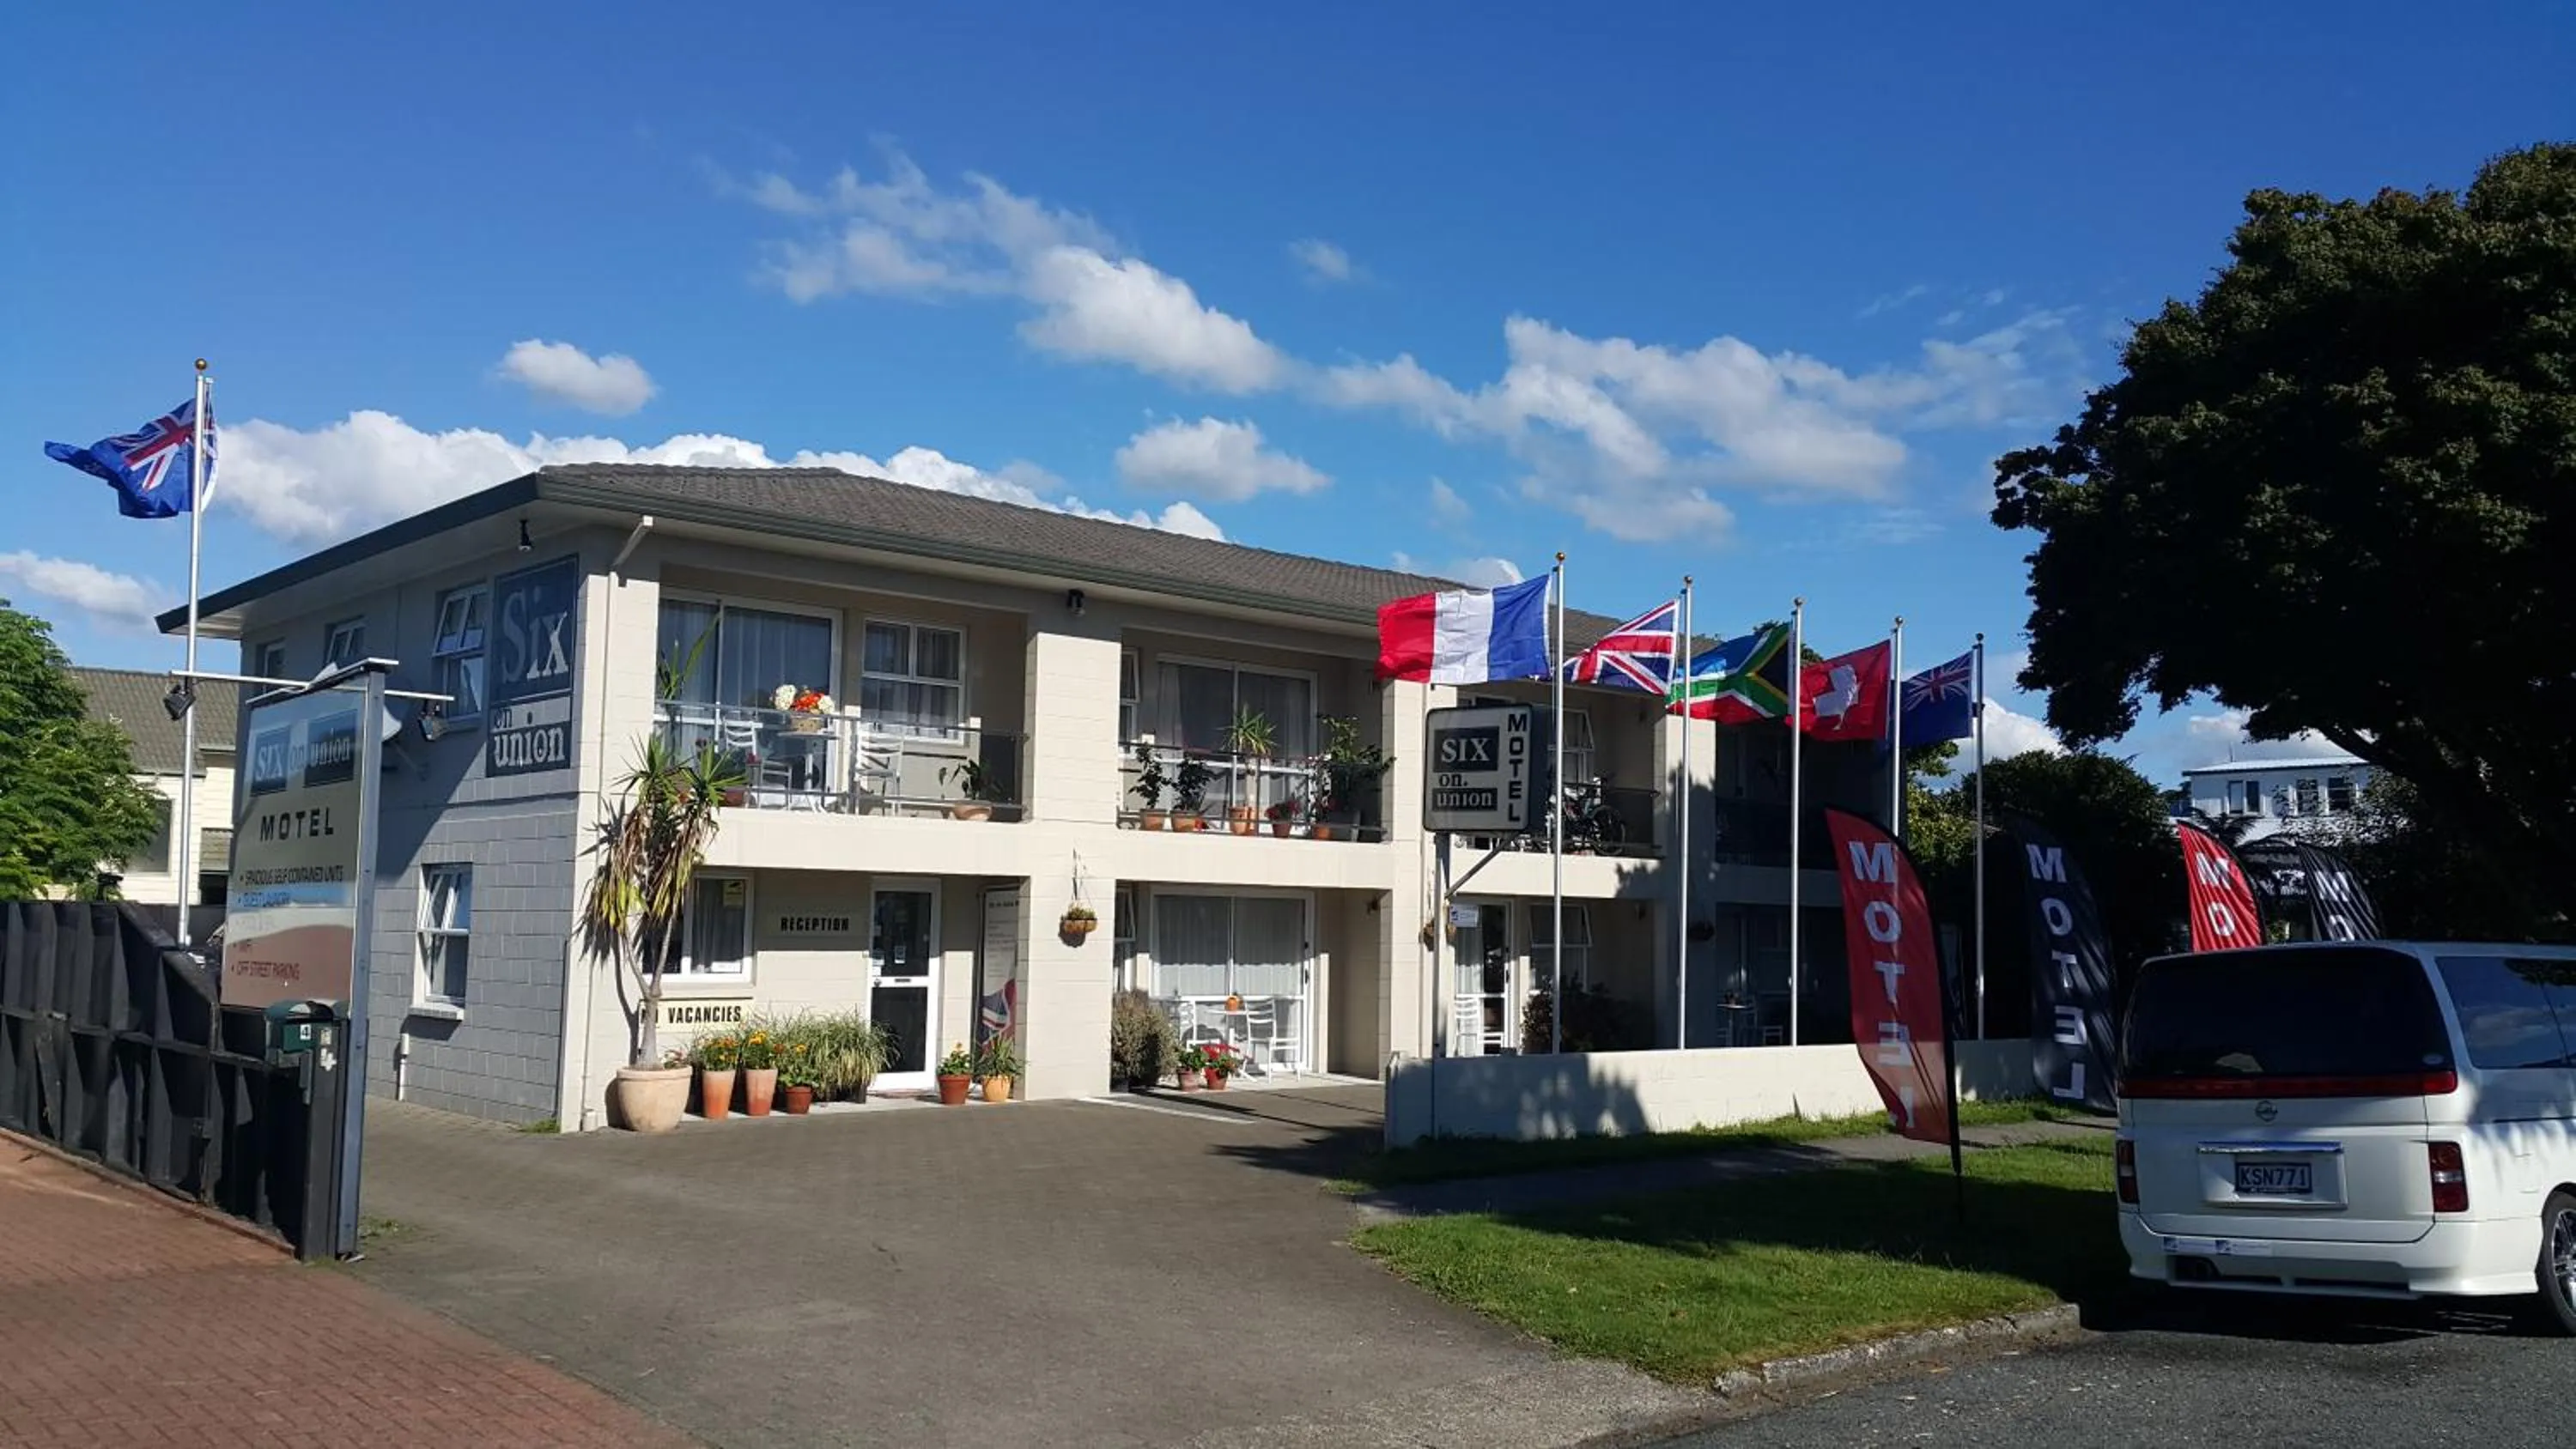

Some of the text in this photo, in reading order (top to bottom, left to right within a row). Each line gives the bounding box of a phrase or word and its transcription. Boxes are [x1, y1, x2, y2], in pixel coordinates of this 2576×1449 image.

[493, 725, 567, 768] union
[1440, 737, 1492, 763] SIX
[1507, 712, 1527, 822] MOTEL
[1436, 791, 1492, 808] union
[260, 807, 334, 842] MOTEL
[780, 915, 850, 932] RECEPTION
[668, 1005, 742, 1024] VACANCIES
[301, 1026, 310, 1037] 4
[2240, 1167, 2306, 1185] KSN771
